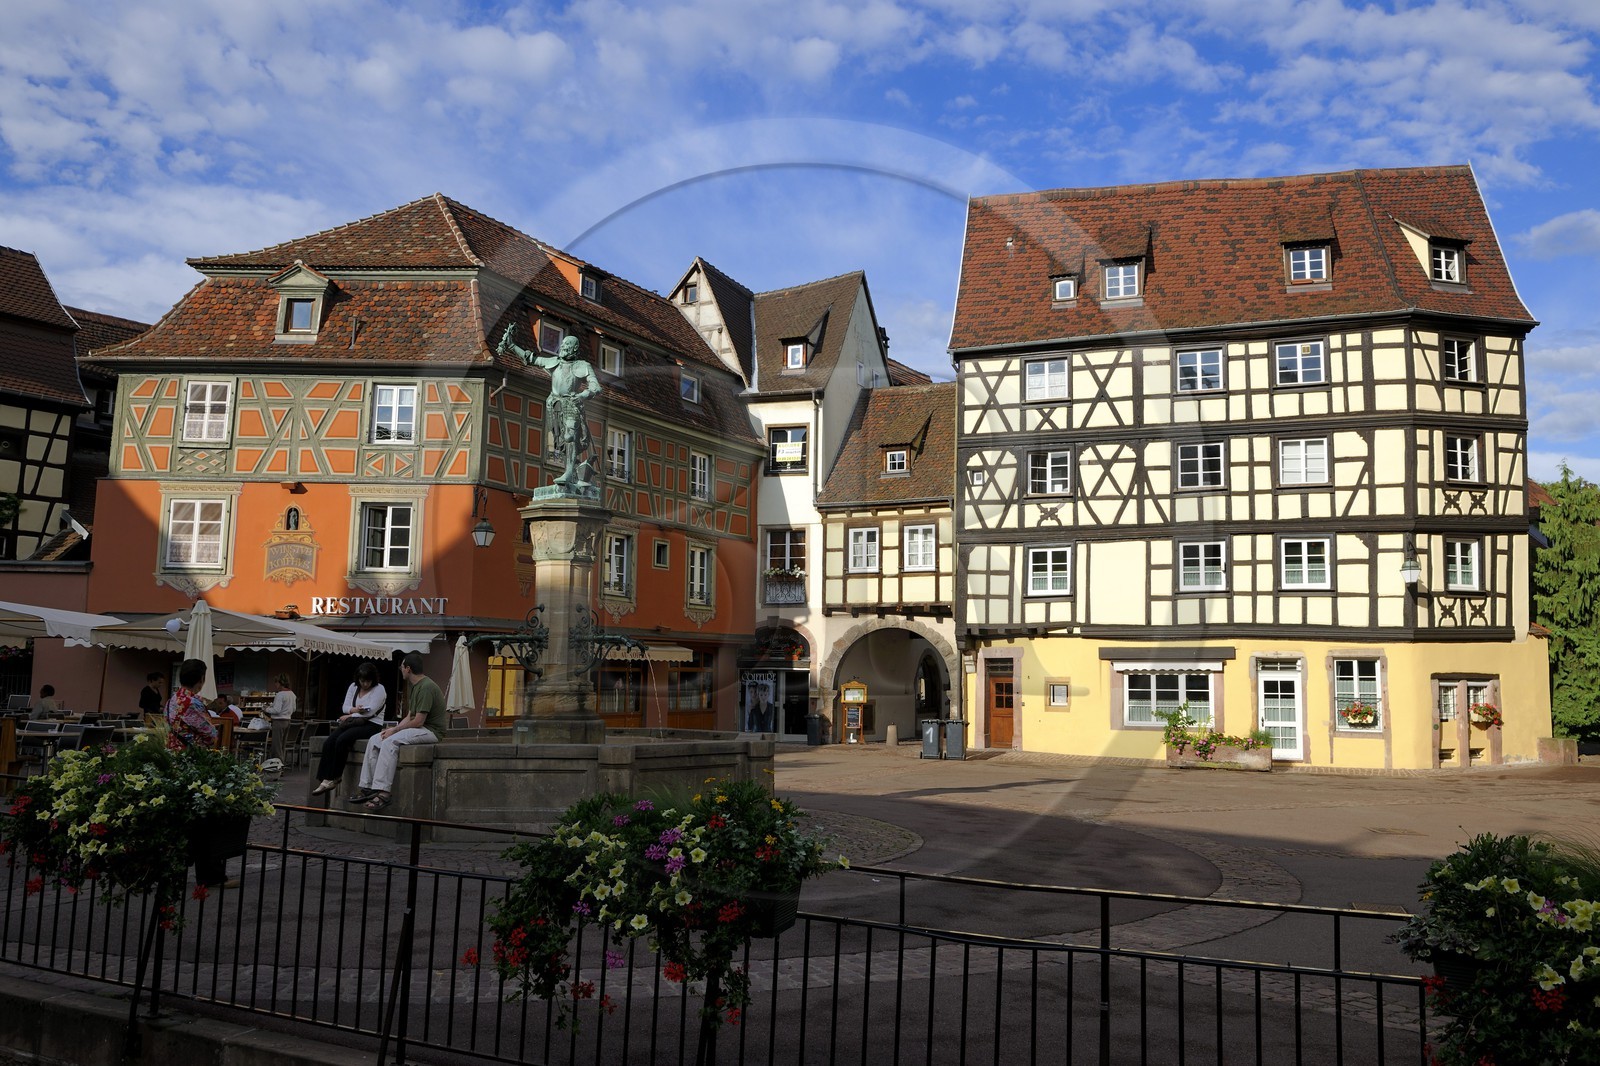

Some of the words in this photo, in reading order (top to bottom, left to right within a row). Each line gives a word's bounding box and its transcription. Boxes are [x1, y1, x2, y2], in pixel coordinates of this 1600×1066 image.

[311, 597, 448, 615] RESTAURANT
[304, 639, 335, 651] RESTAURANT
[741, 671, 777, 681] COIFFURE
[926, 727, 933, 743] 1
